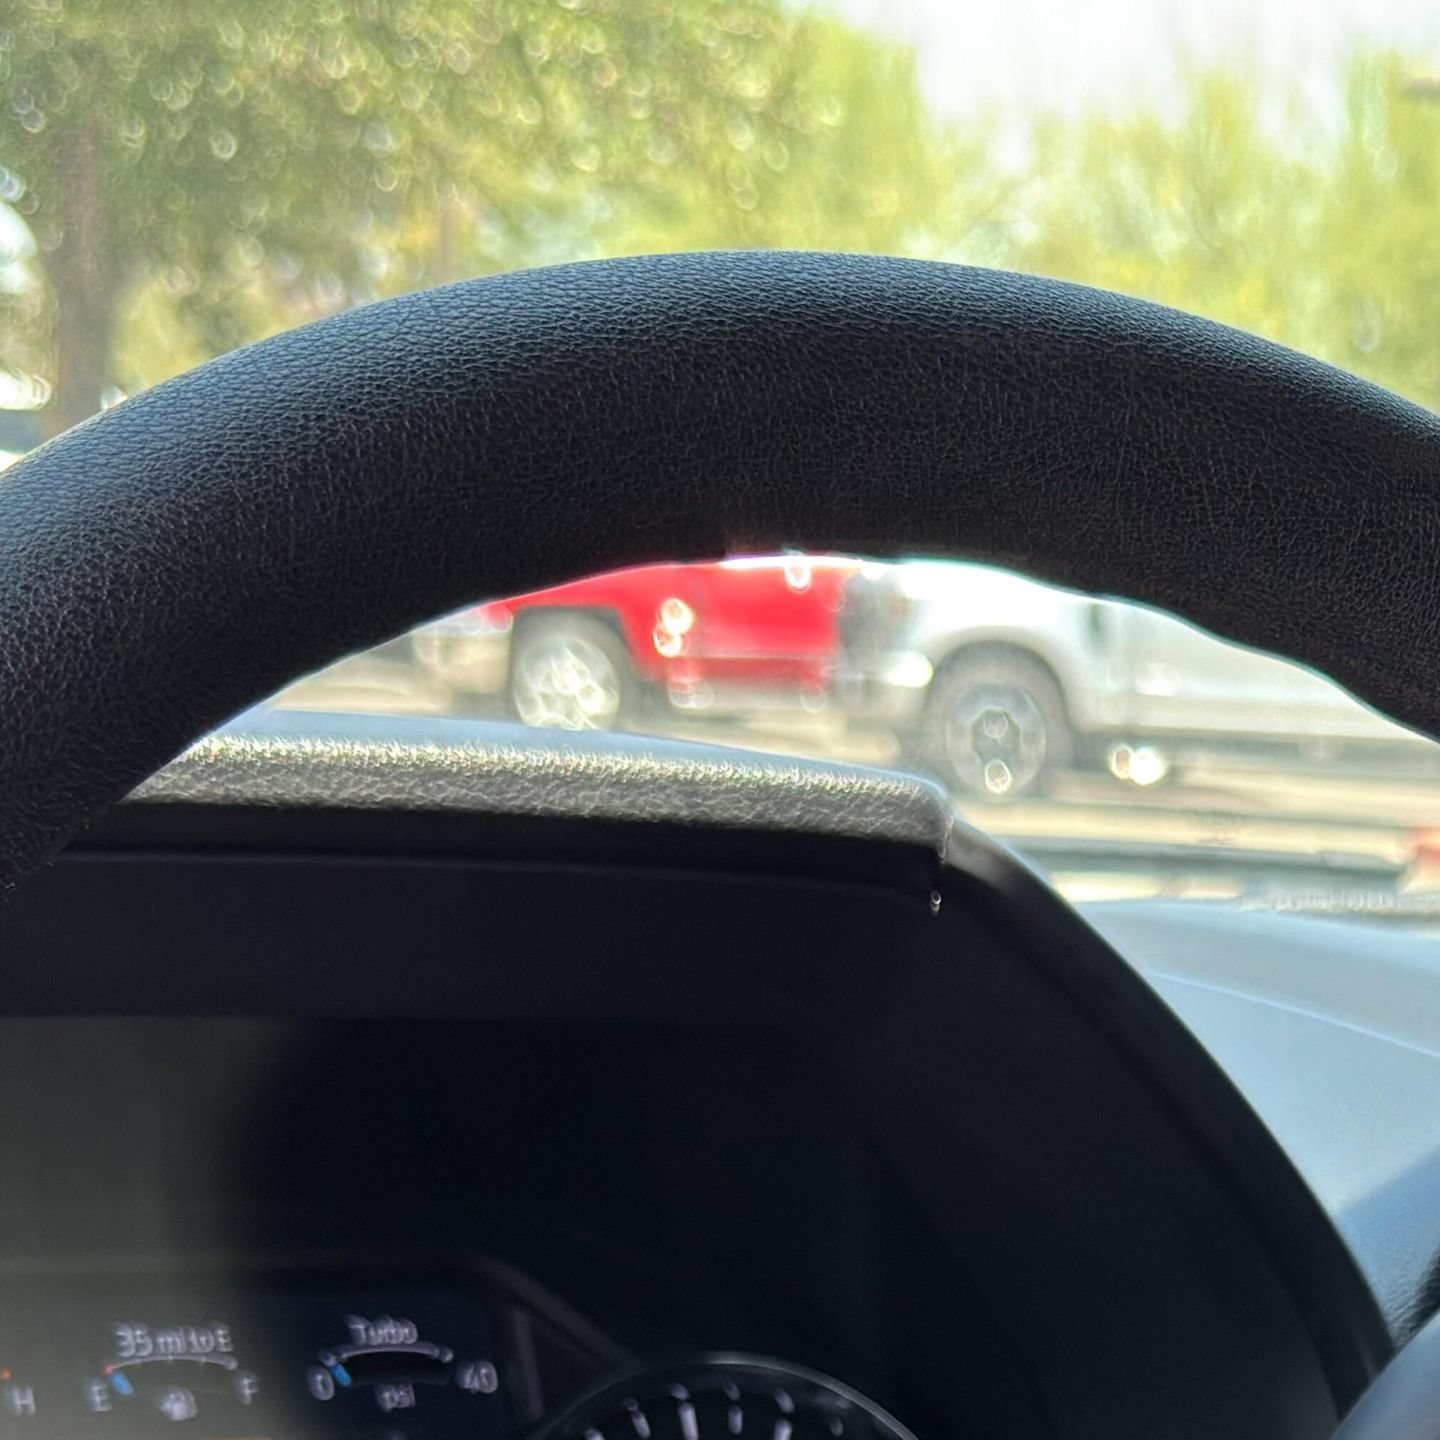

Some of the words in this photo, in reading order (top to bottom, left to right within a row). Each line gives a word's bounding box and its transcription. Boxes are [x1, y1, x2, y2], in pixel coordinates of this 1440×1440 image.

[114, 1322, 153, 1358] 35
[348, 1315, 419, 1345] Turbo
[457, 1359, 499, 1394] 40
[9, 1384, 37, 1416] H
[87, 1376, 112, 1413] E
